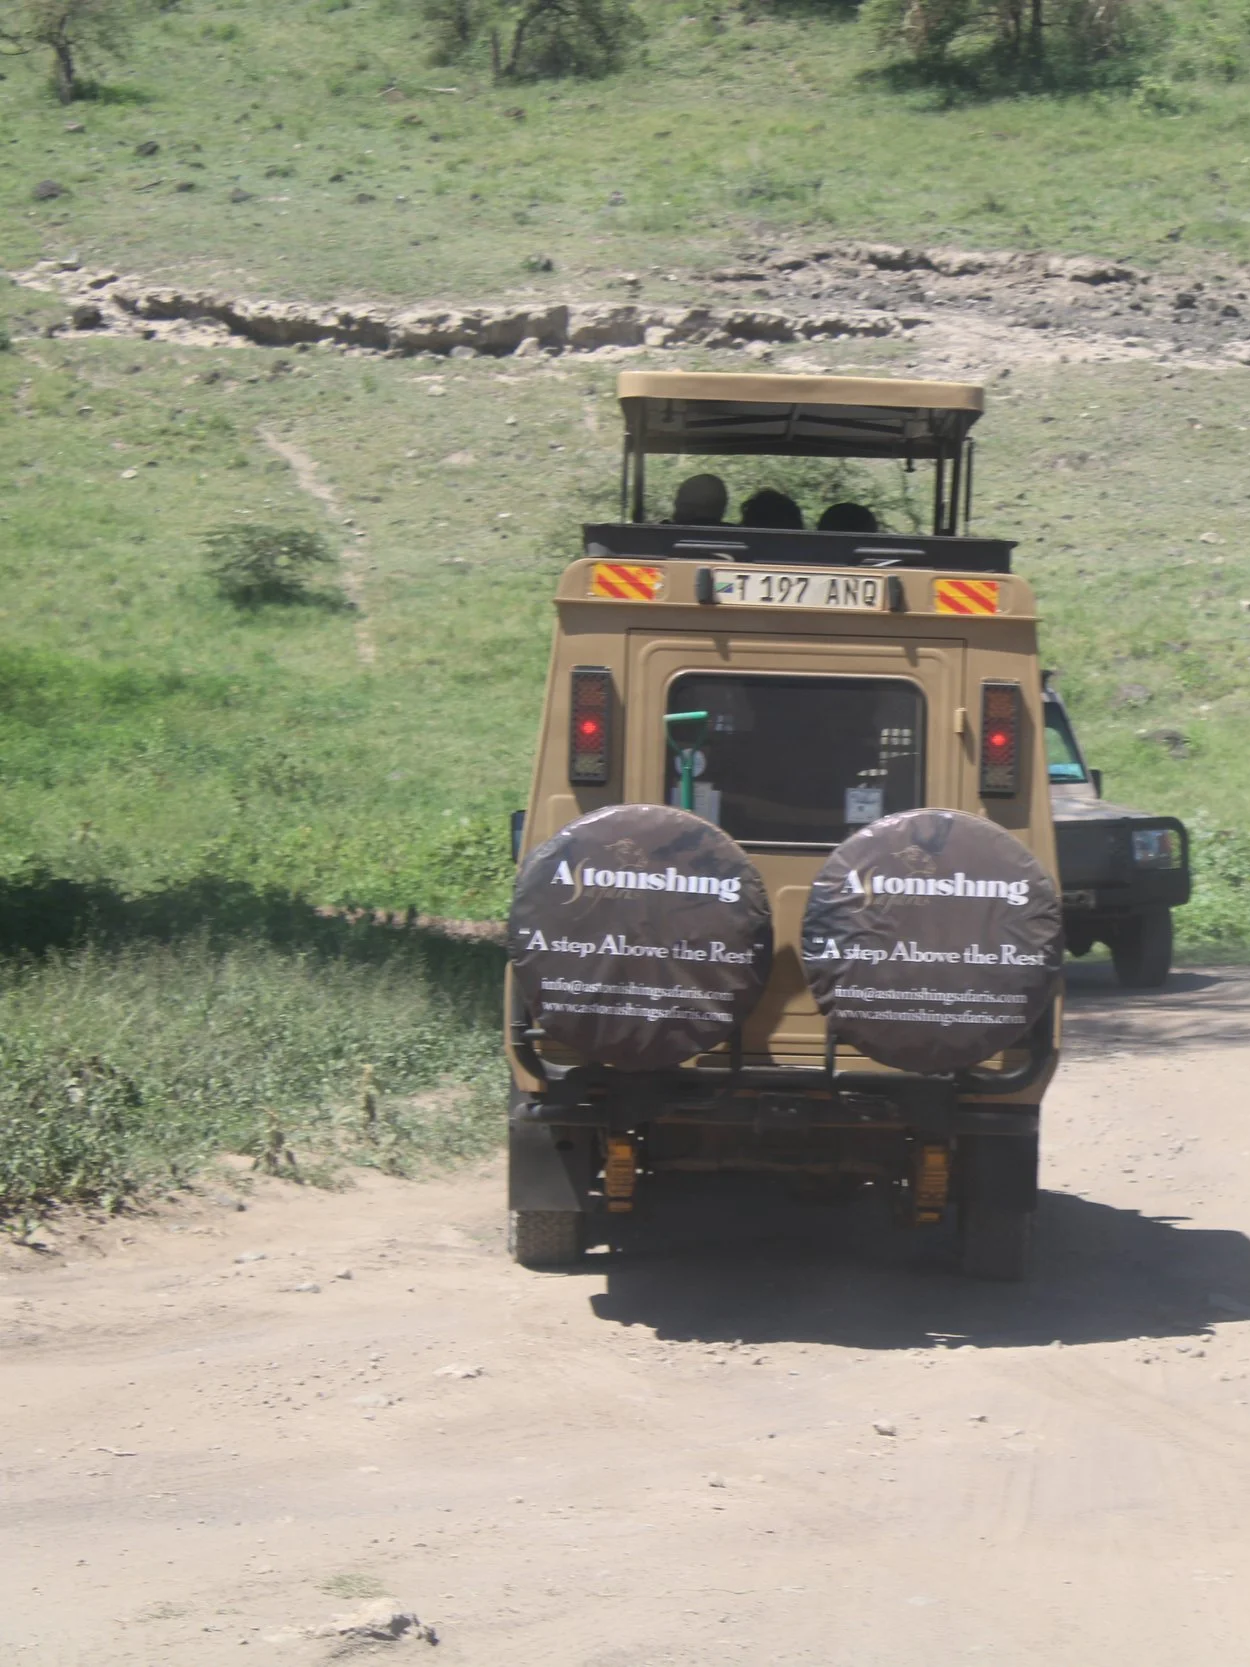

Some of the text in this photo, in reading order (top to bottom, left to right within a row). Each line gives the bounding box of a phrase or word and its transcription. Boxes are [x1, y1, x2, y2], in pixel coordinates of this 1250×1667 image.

[735, 575, 876, 608] T 197 ANQ
[550, 859, 741, 903] Astonishing
[840, 868, 1029, 905] Astonishing
[551, 936, 596, 958] step
[597, 934, 669, 958] Above
[672, 939, 707, 962] the
[843, 944, 888, 965] step
[888, 941, 960, 963] Above
[964, 944, 998, 965] the
[541, 977, 734, 1000] info@astonishingsafaris.com
[834, 985, 1028, 1005] info@astonishingsafaris.com
[541, 1001, 734, 1022] www.astonishingsafaris.com
[834, 1008, 1026, 1026] www.astonishingsafaris.com
